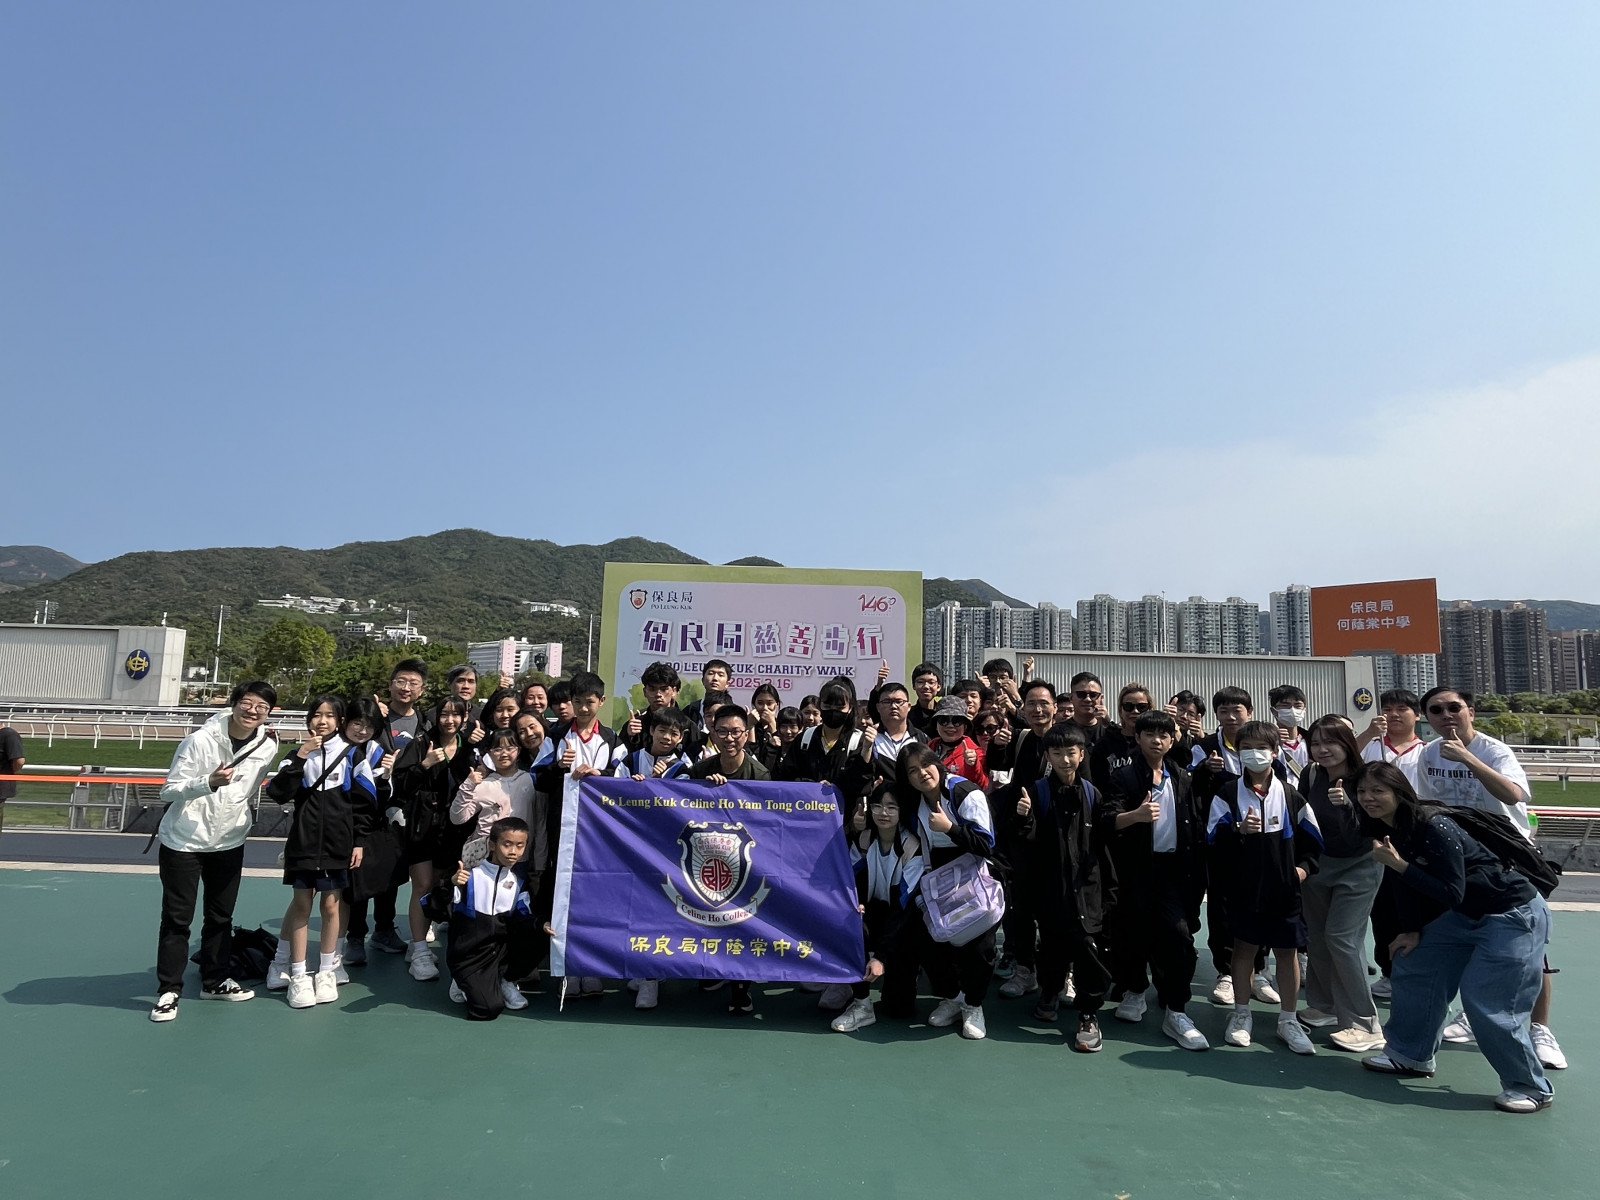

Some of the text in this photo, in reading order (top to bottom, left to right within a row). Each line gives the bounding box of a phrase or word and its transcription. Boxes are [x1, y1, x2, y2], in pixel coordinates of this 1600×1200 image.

[652, 590, 693, 603] 保良局
[1350, 599, 1394, 614] 保良局
[1337, 615, 1410, 631] 何蔭棠中學
[757, 664, 812, 675] CHARITY
[816, 666, 854, 676] WALK
[1427, 767, 1446, 778] DEVIL
[601, 795, 836, 813] Po Leung Kuk Celine Ho Yam Tong College
[681, 904, 706, 920] Celine
[708, 913, 720, 922] Ho
[629, 935, 814, 959] 保良局何蔭棠中學
